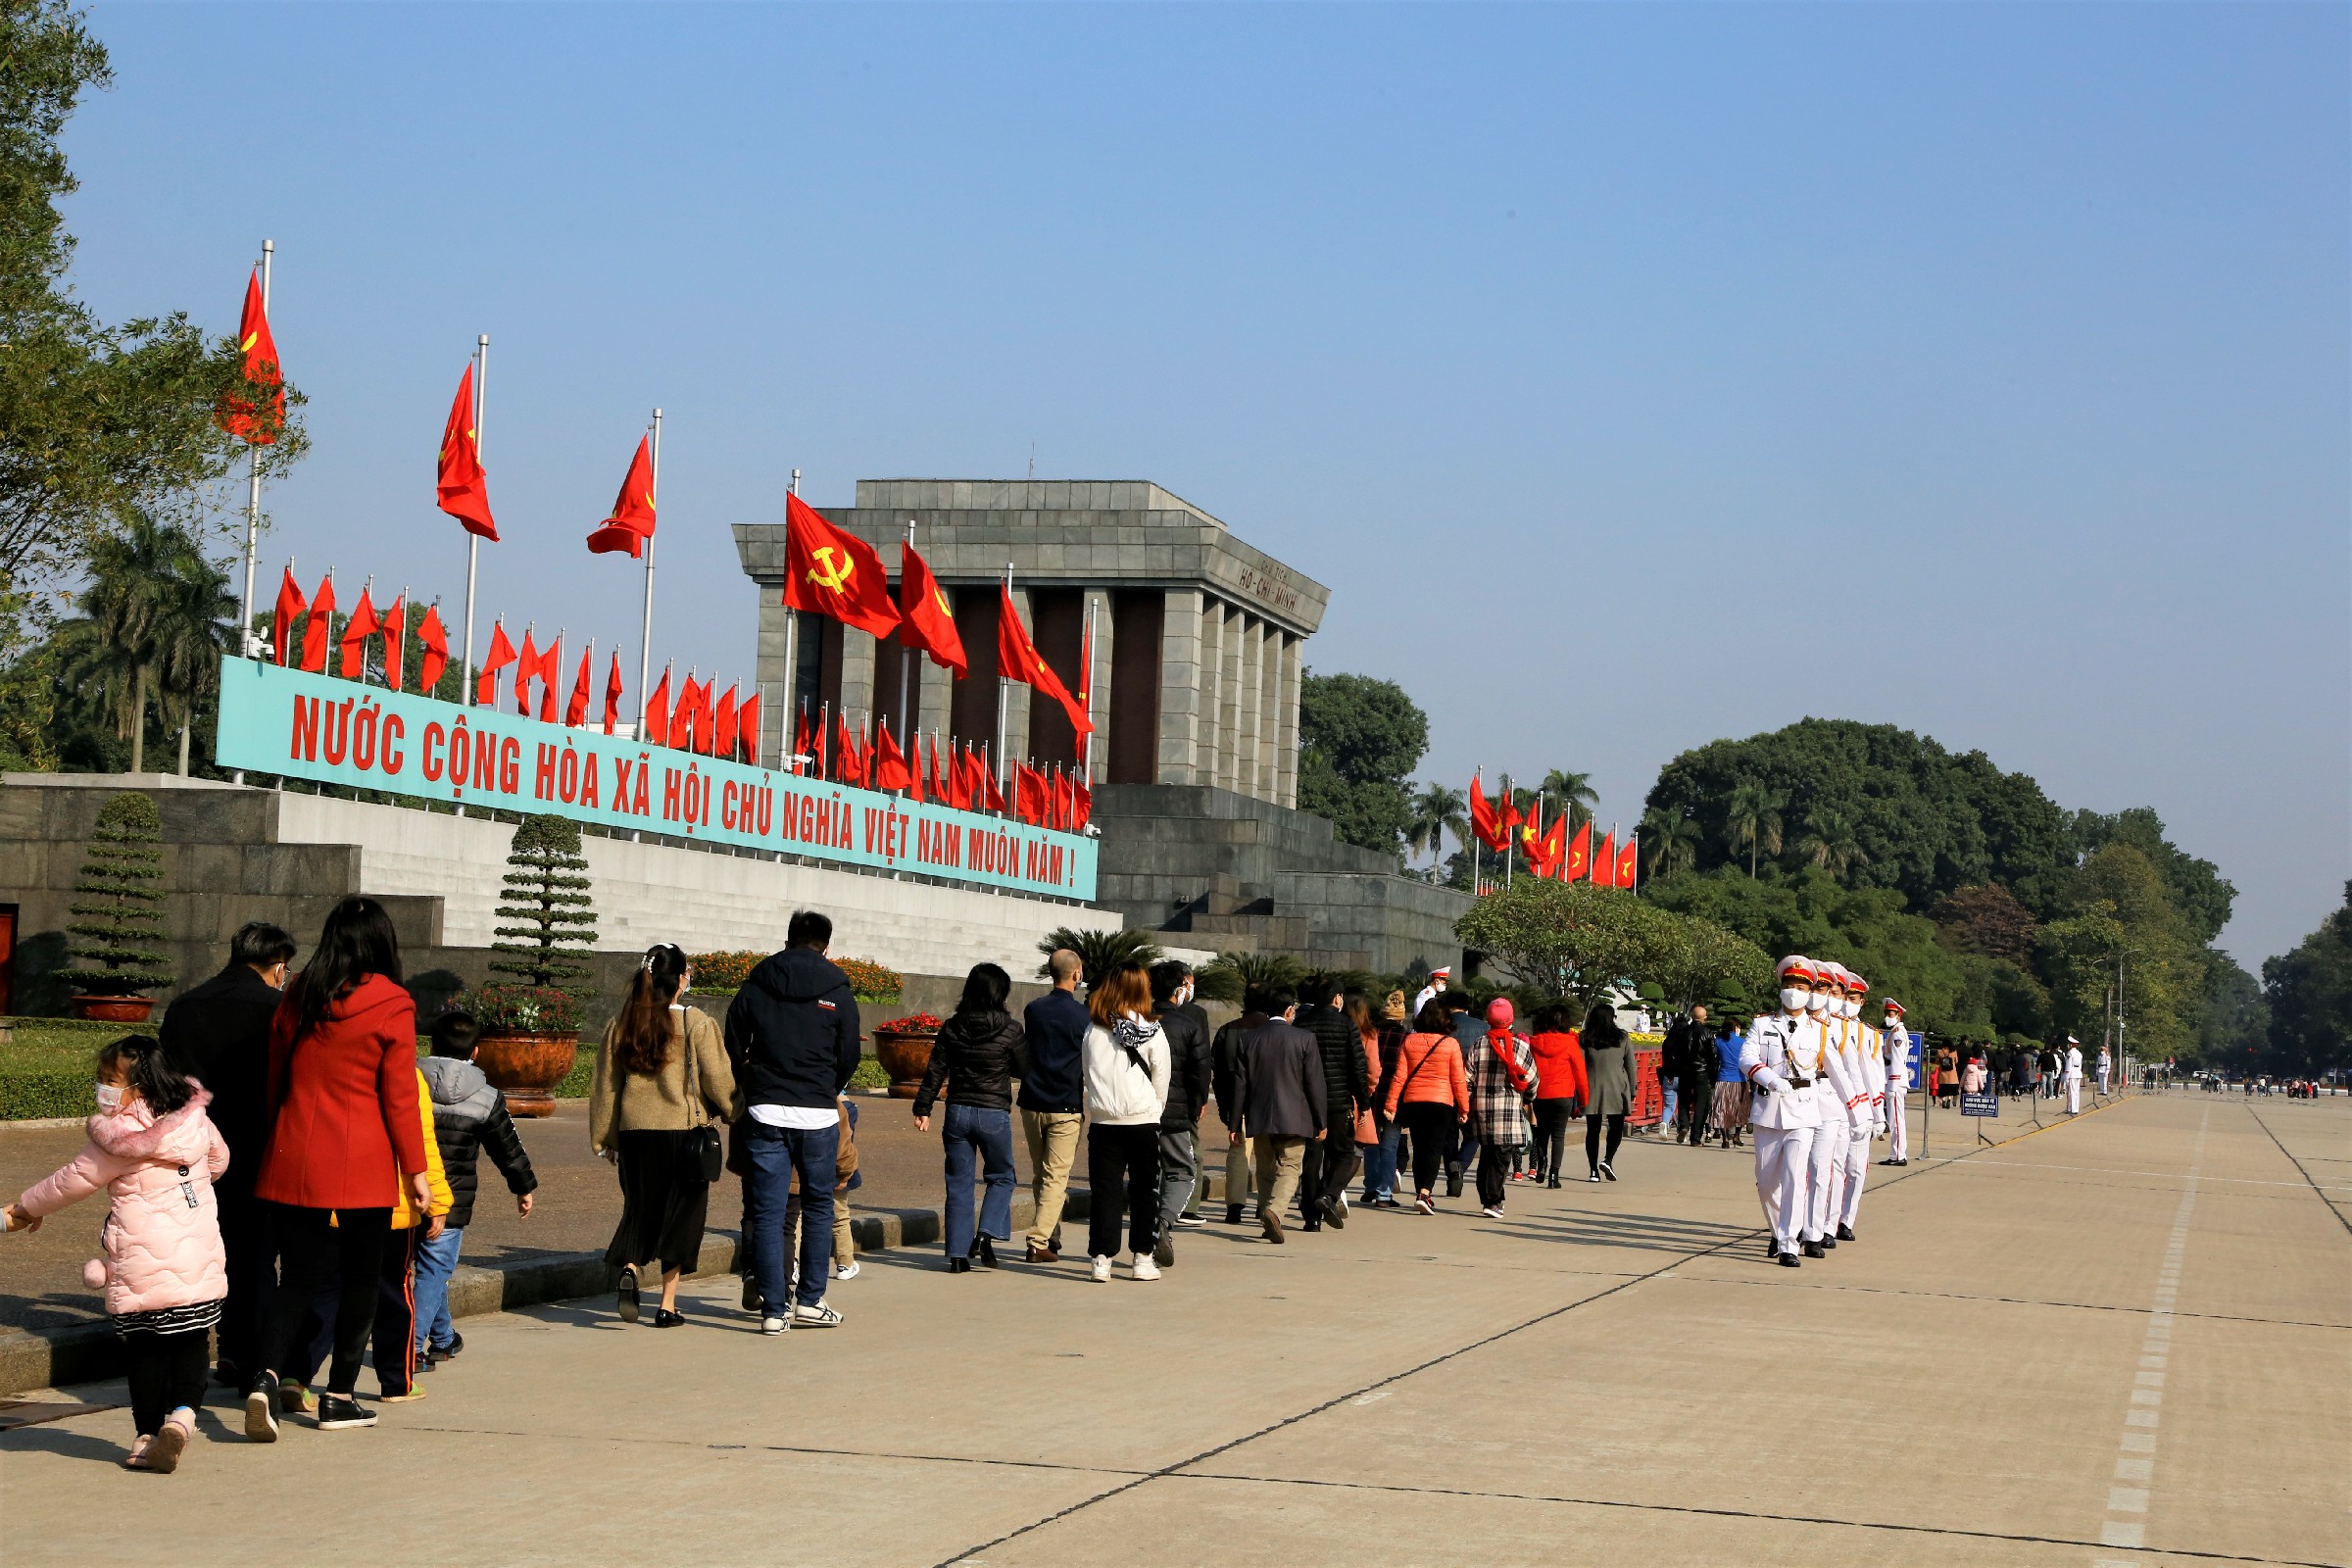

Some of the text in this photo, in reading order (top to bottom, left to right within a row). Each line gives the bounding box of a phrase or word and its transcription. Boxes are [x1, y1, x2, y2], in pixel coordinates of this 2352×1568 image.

[290, 695, 405, 775] NƯỚC
[422, 713, 520, 798] CỘNG
[535, 736, 599, 808] HÒA
[612, 752, 650, 816] XÃ
[663, 761, 711, 834] HỘI
[722, 771, 773, 837] CHỦ
[783, 791, 854, 850] NGHĨA
[864, 802, 909, 865] VIỆT
[917, 818, 961, 867] NAM
[968, 825, 1020, 877] MUÔN
[1026, 835, 1063, 886] NĂM
